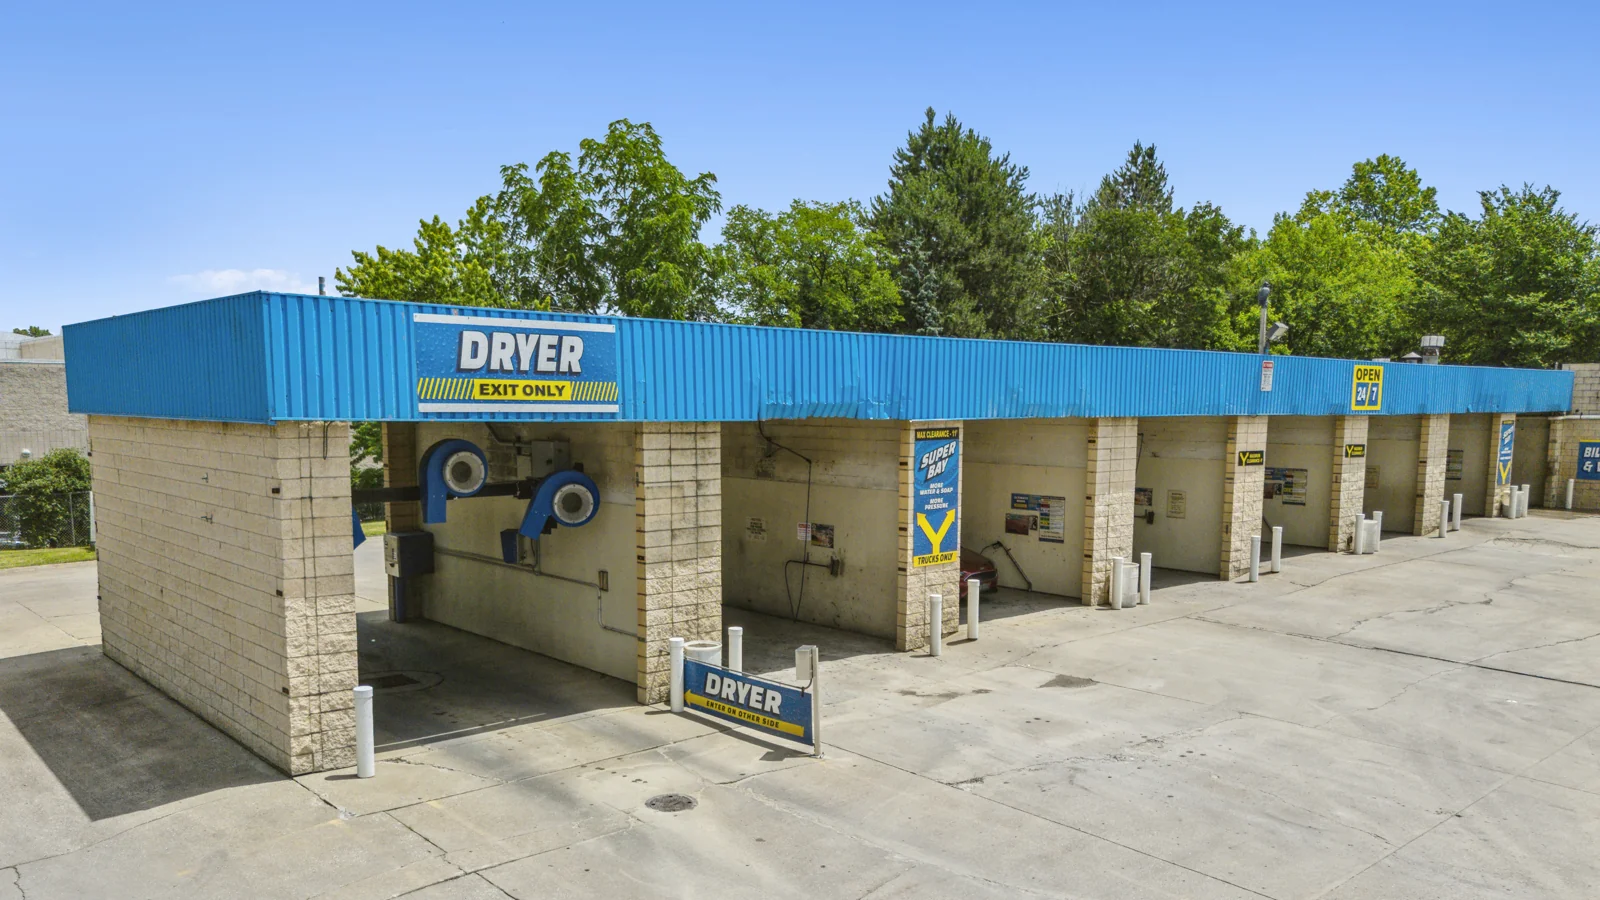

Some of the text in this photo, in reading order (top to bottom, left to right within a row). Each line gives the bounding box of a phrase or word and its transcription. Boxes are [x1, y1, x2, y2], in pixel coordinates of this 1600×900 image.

[458, 330, 584, 373] DRYER
[1356, 368, 1380, 381] OPEN
[479, 383, 566, 397] EXIT ONLY
[916, 431, 926, 439] MAX
[926, 430, 950, 439] CLEARANCE
[920, 440, 957, 469] SUPER
[927, 457, 949, 480] BAY
[1583, 461, 1594, 473] &
[919, 488, 936, 496] WATER
[924, 502, 949, 511] PRESSURE
[918, 552, 954, 565] TRUCKS ONLY
[705, 671, 782, 715] DRYER
[706, 700, 780, 729] ENTER ON OTHER SIDE
